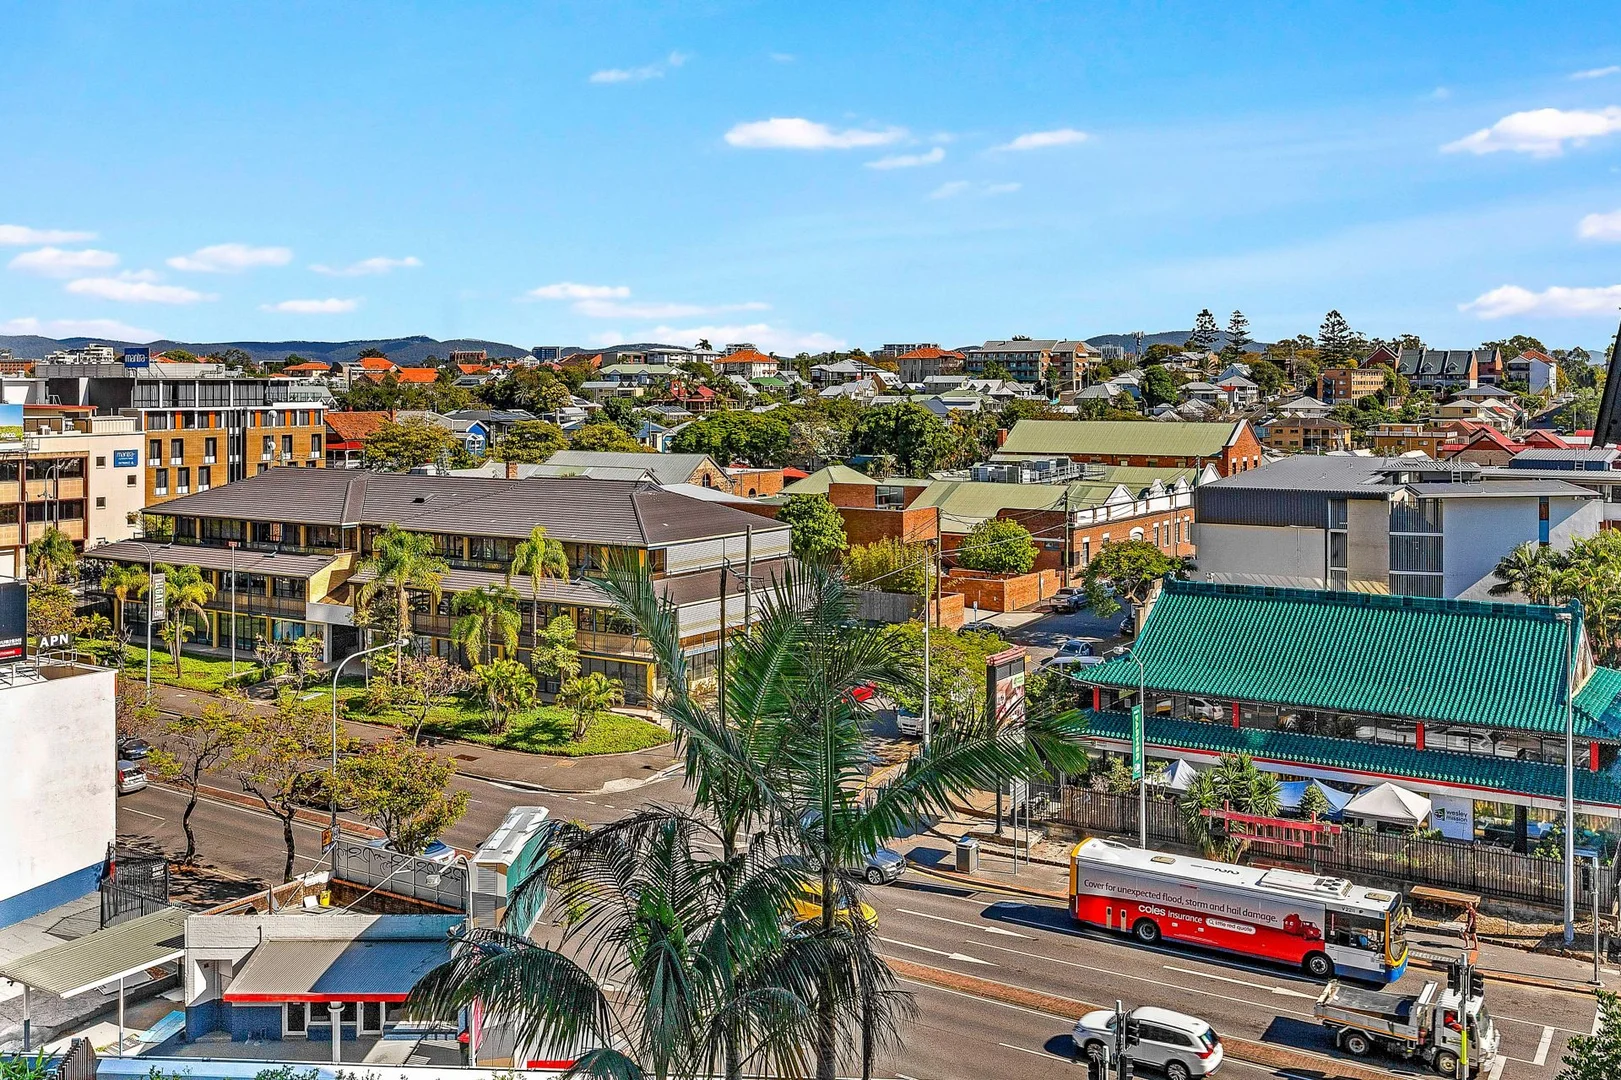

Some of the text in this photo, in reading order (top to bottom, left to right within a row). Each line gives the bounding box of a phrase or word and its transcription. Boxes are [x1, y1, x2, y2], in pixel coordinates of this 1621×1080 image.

[124, 352, 146, 363] mantra
[39, 633, 69, 648] APN
[1446, 810, 1468, 818] wesley
[1083, 879, 1278, 924] Cover for unexpected flood, storm and hail damage.
[1138, 904, 1166, 916] coles
[1214, 920, 1226, 928] little
[1236, 924, 1253, 933] quote
